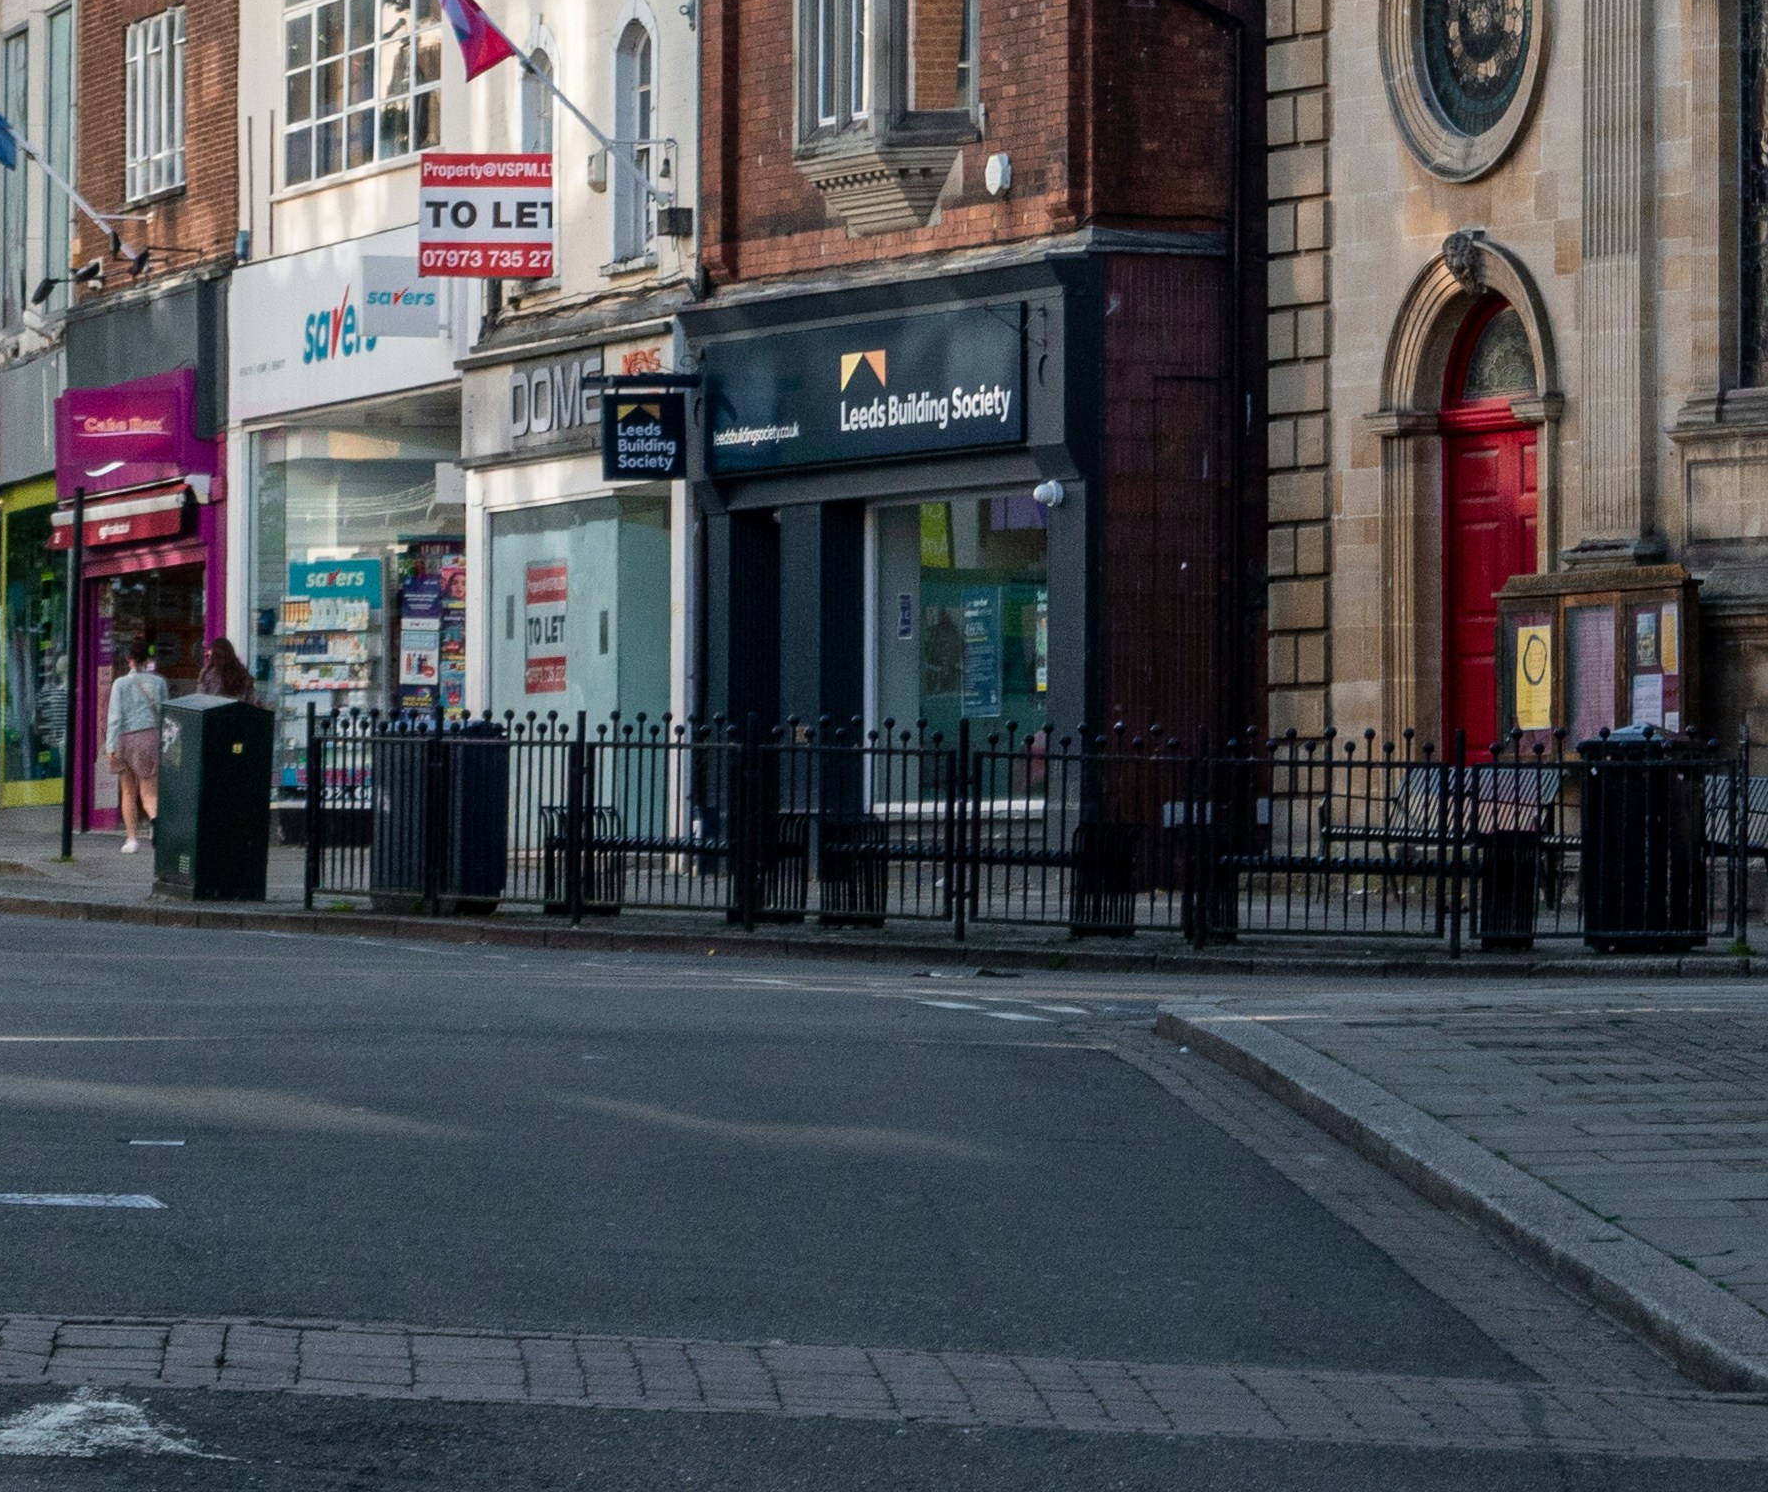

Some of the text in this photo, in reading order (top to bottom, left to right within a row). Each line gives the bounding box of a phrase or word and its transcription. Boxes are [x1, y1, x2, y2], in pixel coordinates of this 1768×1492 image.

[425, 200, 477, 229] TO
[422, 249, 483, 268] 07973
[488, 250, 523, 268] 735
[367, 287, 436, 306] savers
[840, 384, 1012, 431] Leeds Building Society
[84, 417, 127, 432] Cake
[617, 422, 662, 437] Leeds
[713, 421, 800, 447] leedsbuildingsociety.co.uk
[618, 439, 676, 455] Building
[618, 454, 674, 471] Society
[306, 567, 365, 588] savers
[528, 614, 565, 646] TO LET
